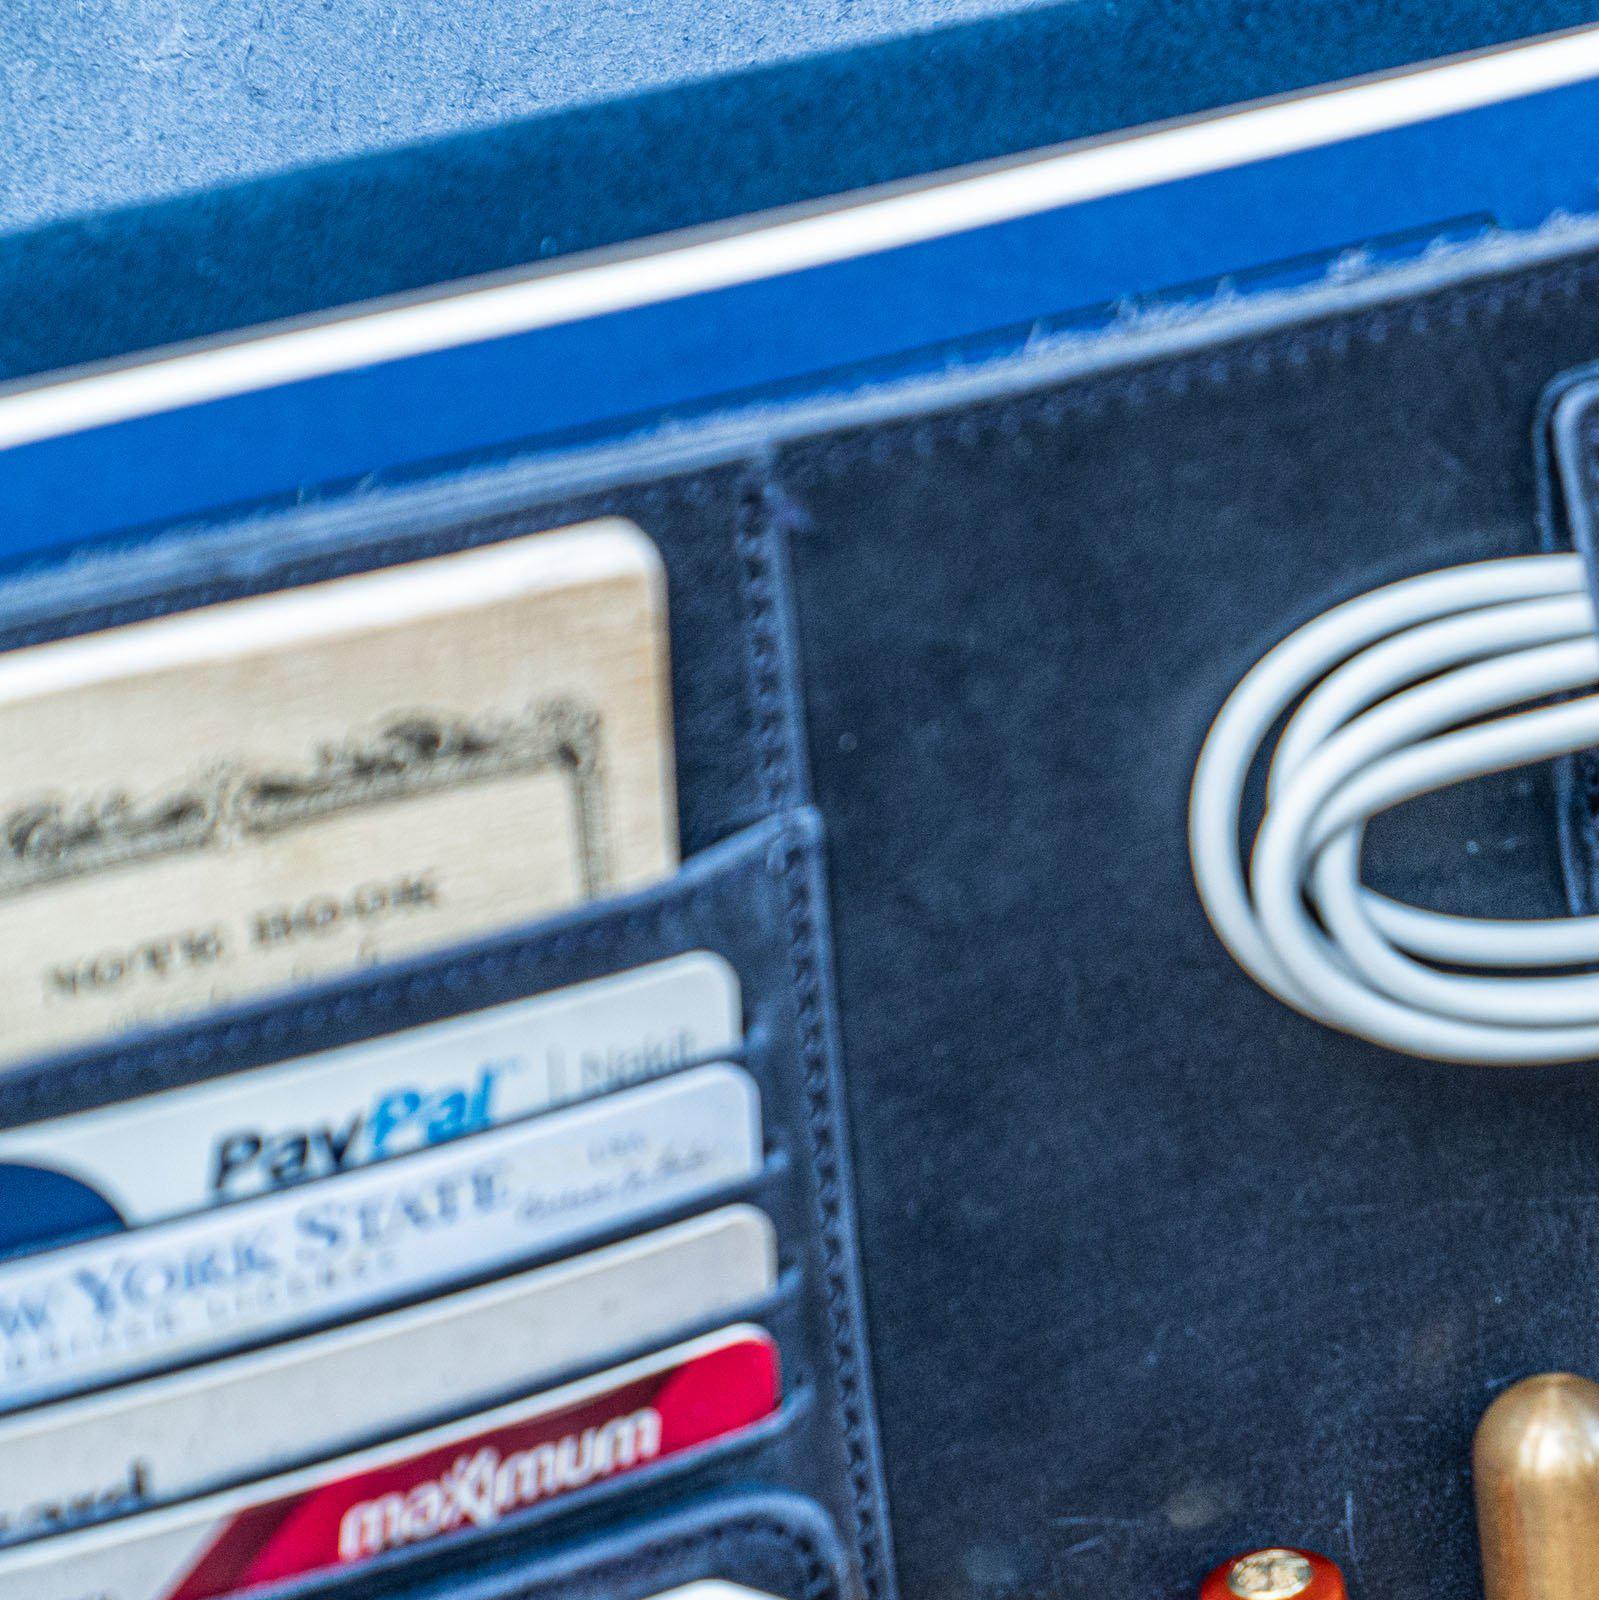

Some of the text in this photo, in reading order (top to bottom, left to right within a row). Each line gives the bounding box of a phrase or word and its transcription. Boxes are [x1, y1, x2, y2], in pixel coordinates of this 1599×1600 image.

[211, 1066, 496, 1191] PayPal
[73, 1227, 277, 1318] YORK
[295, 1170, 508, 1248] STATE
